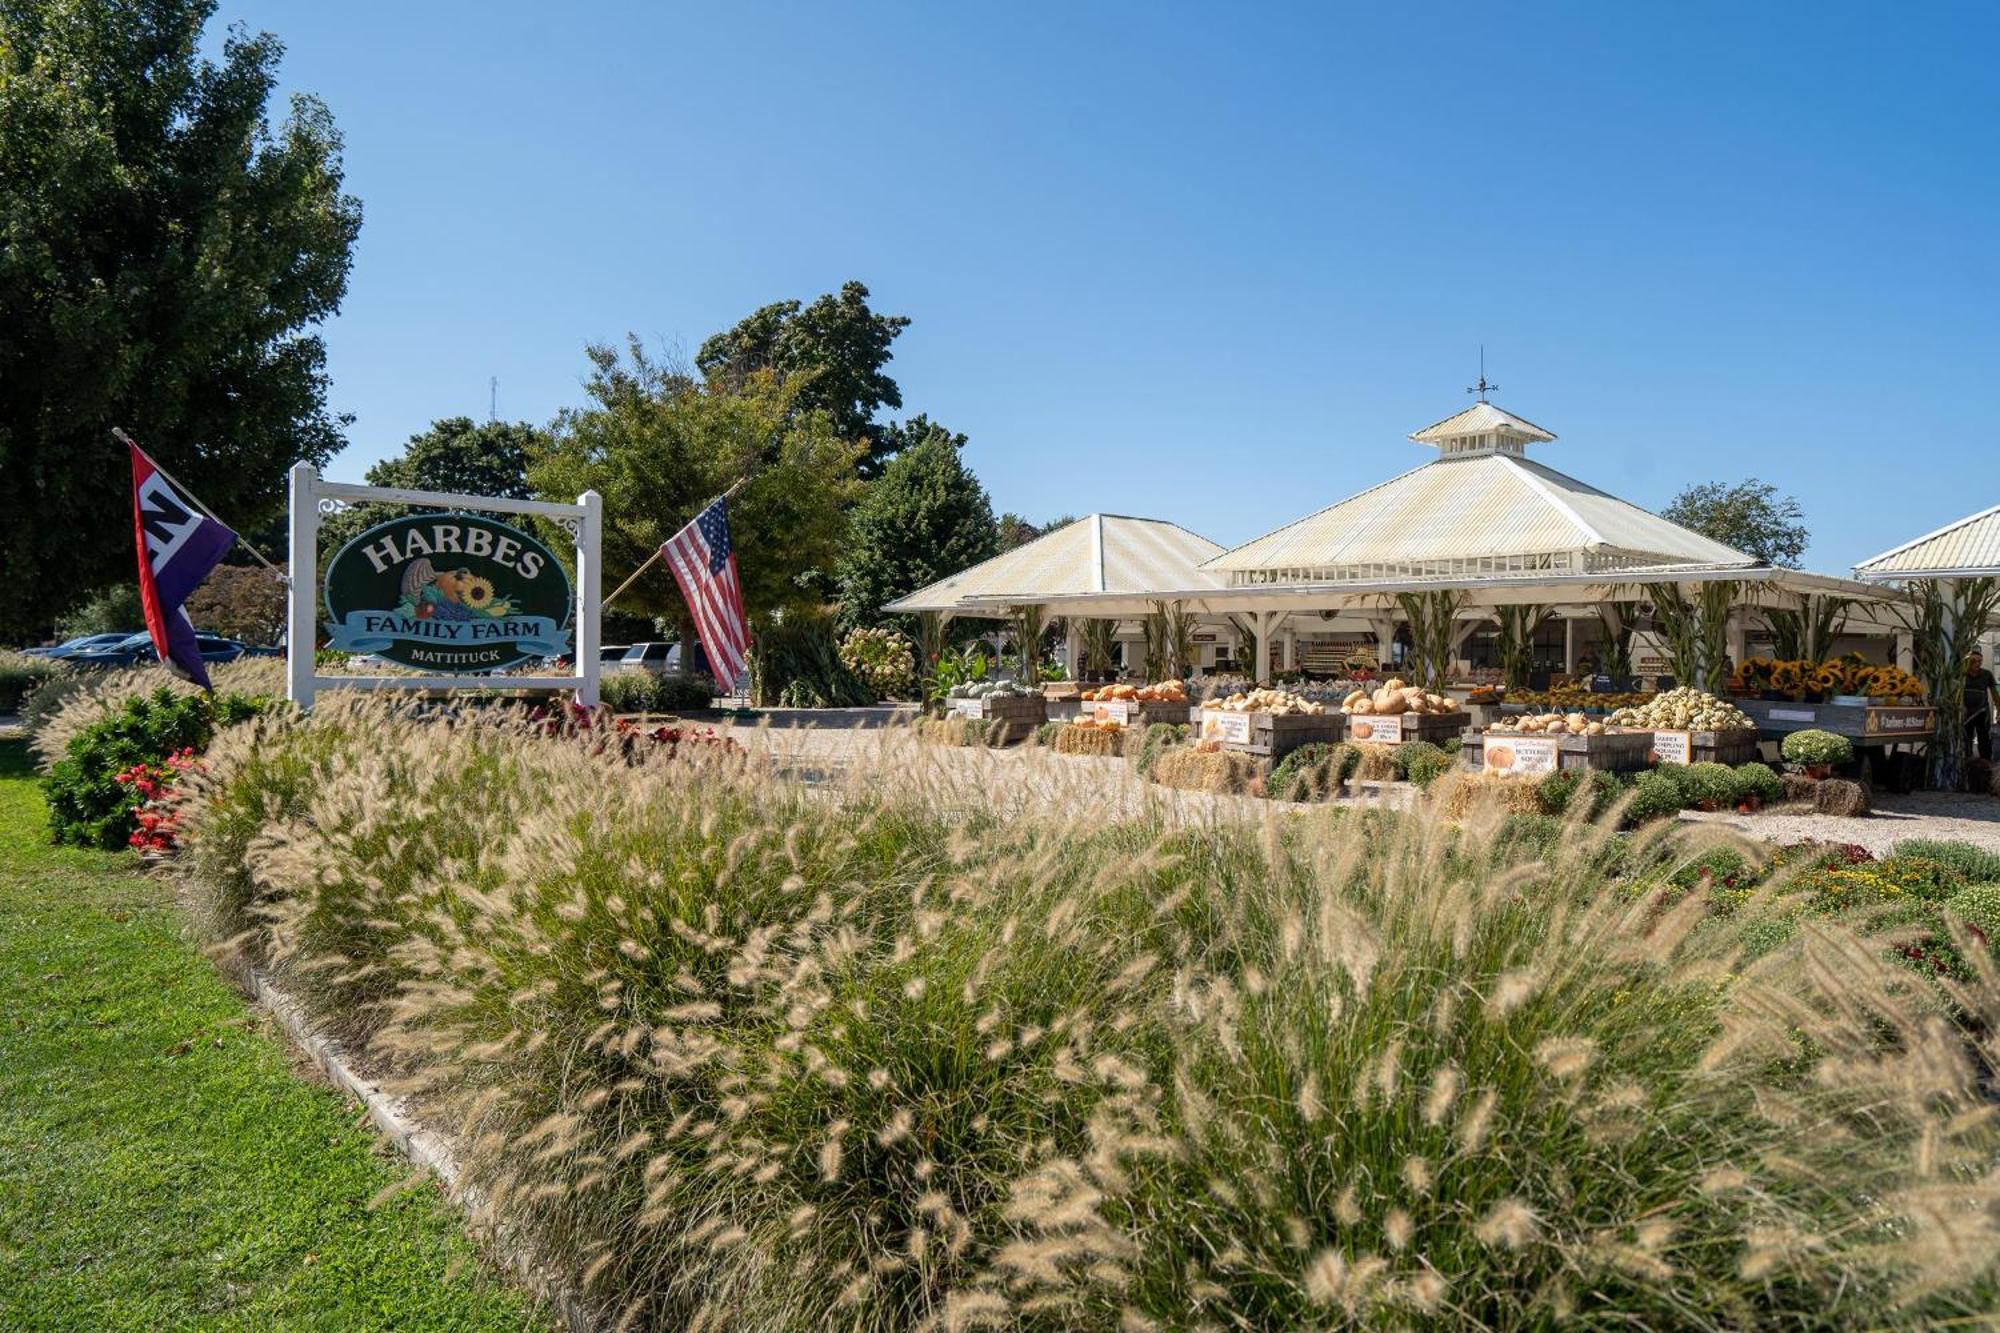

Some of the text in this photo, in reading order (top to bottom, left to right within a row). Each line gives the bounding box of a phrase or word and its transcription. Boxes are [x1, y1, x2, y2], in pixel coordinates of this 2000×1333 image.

[362, 525, 545, 580] HARBES
[365, 616, 540, 639] FAMILY FARM
[411, 649, 501, 664] MATTITUCK
